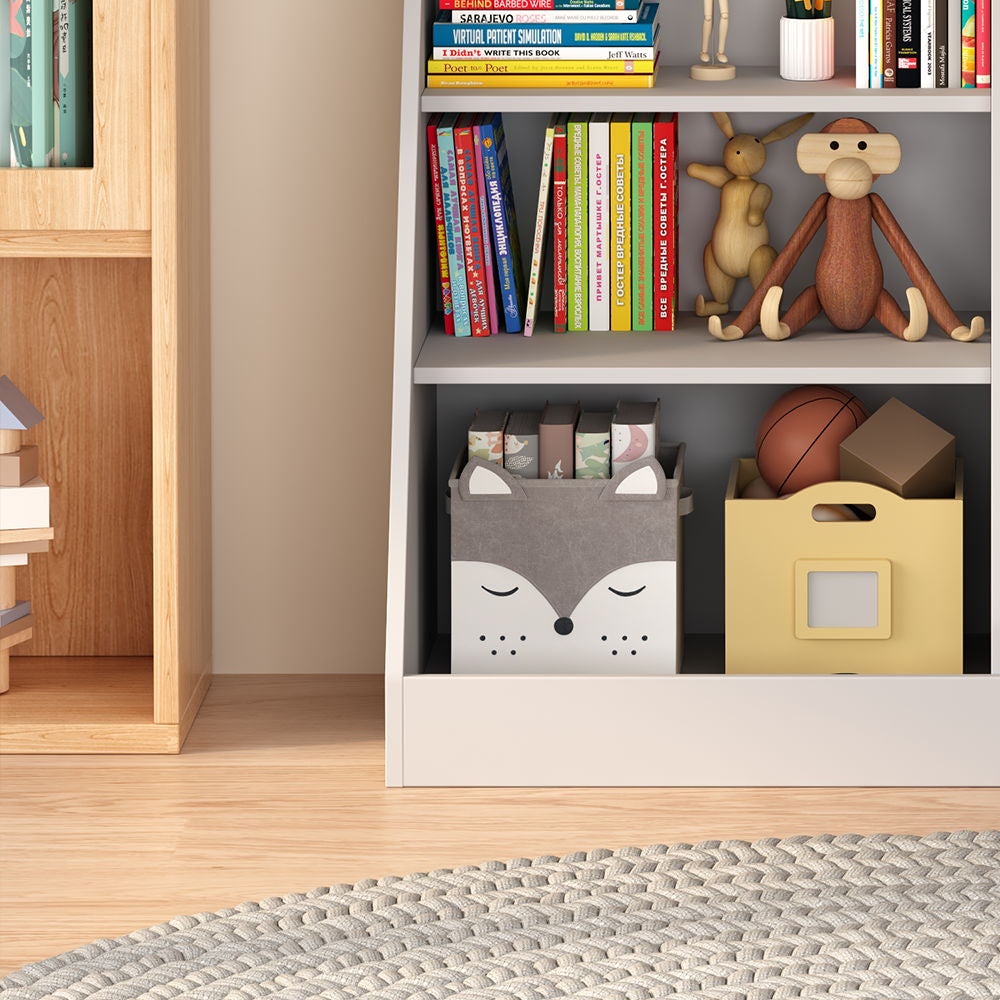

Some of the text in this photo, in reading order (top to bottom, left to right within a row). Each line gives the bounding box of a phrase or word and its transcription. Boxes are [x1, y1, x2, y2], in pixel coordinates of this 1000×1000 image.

[454, 0, 552, 8] BEHIND BARBED WIRE
[460, 14, 547, 23] SARAJEVO ROSES
[452, 29, 562, 44] VIRTUAL PATIENT SIMULATION
[885, 17, 893, 40] Patricia
[902, 15, 912, 42] SYSTEMS
[444, 63, 467, 72] Poet
[485, 63, 508, 72] Poet
[607, 51, 624, 59] Jeff
[573, 124, 582, 155] ВРЕДНЫЕ
[457, 159, 469, 211] ВОПРОСАХ
[616, 154, 624, 202] СОВЕТЫ
[490, 180, 508, 255] ЭНЦИКЛОПЕДИЯ
[555, 185, 563, 219] ТОЛЬКО
[616, 204, 625, 258] ВРЕДНЫЕ
[573, 248, 582, 292] ВОСПИТАНИЕ
[616, 260, 624, 297] ОСТЕР
[660, 240, 668, 291] ВРЕДНЫЕ
[469, 288, 479, 323] ДЕВОЧЕК
[475, 279, 488, 330] ДЛЯ ЛУЧШИХ
[573, 293, 582, 328] ВЗРОСЛЫХ
